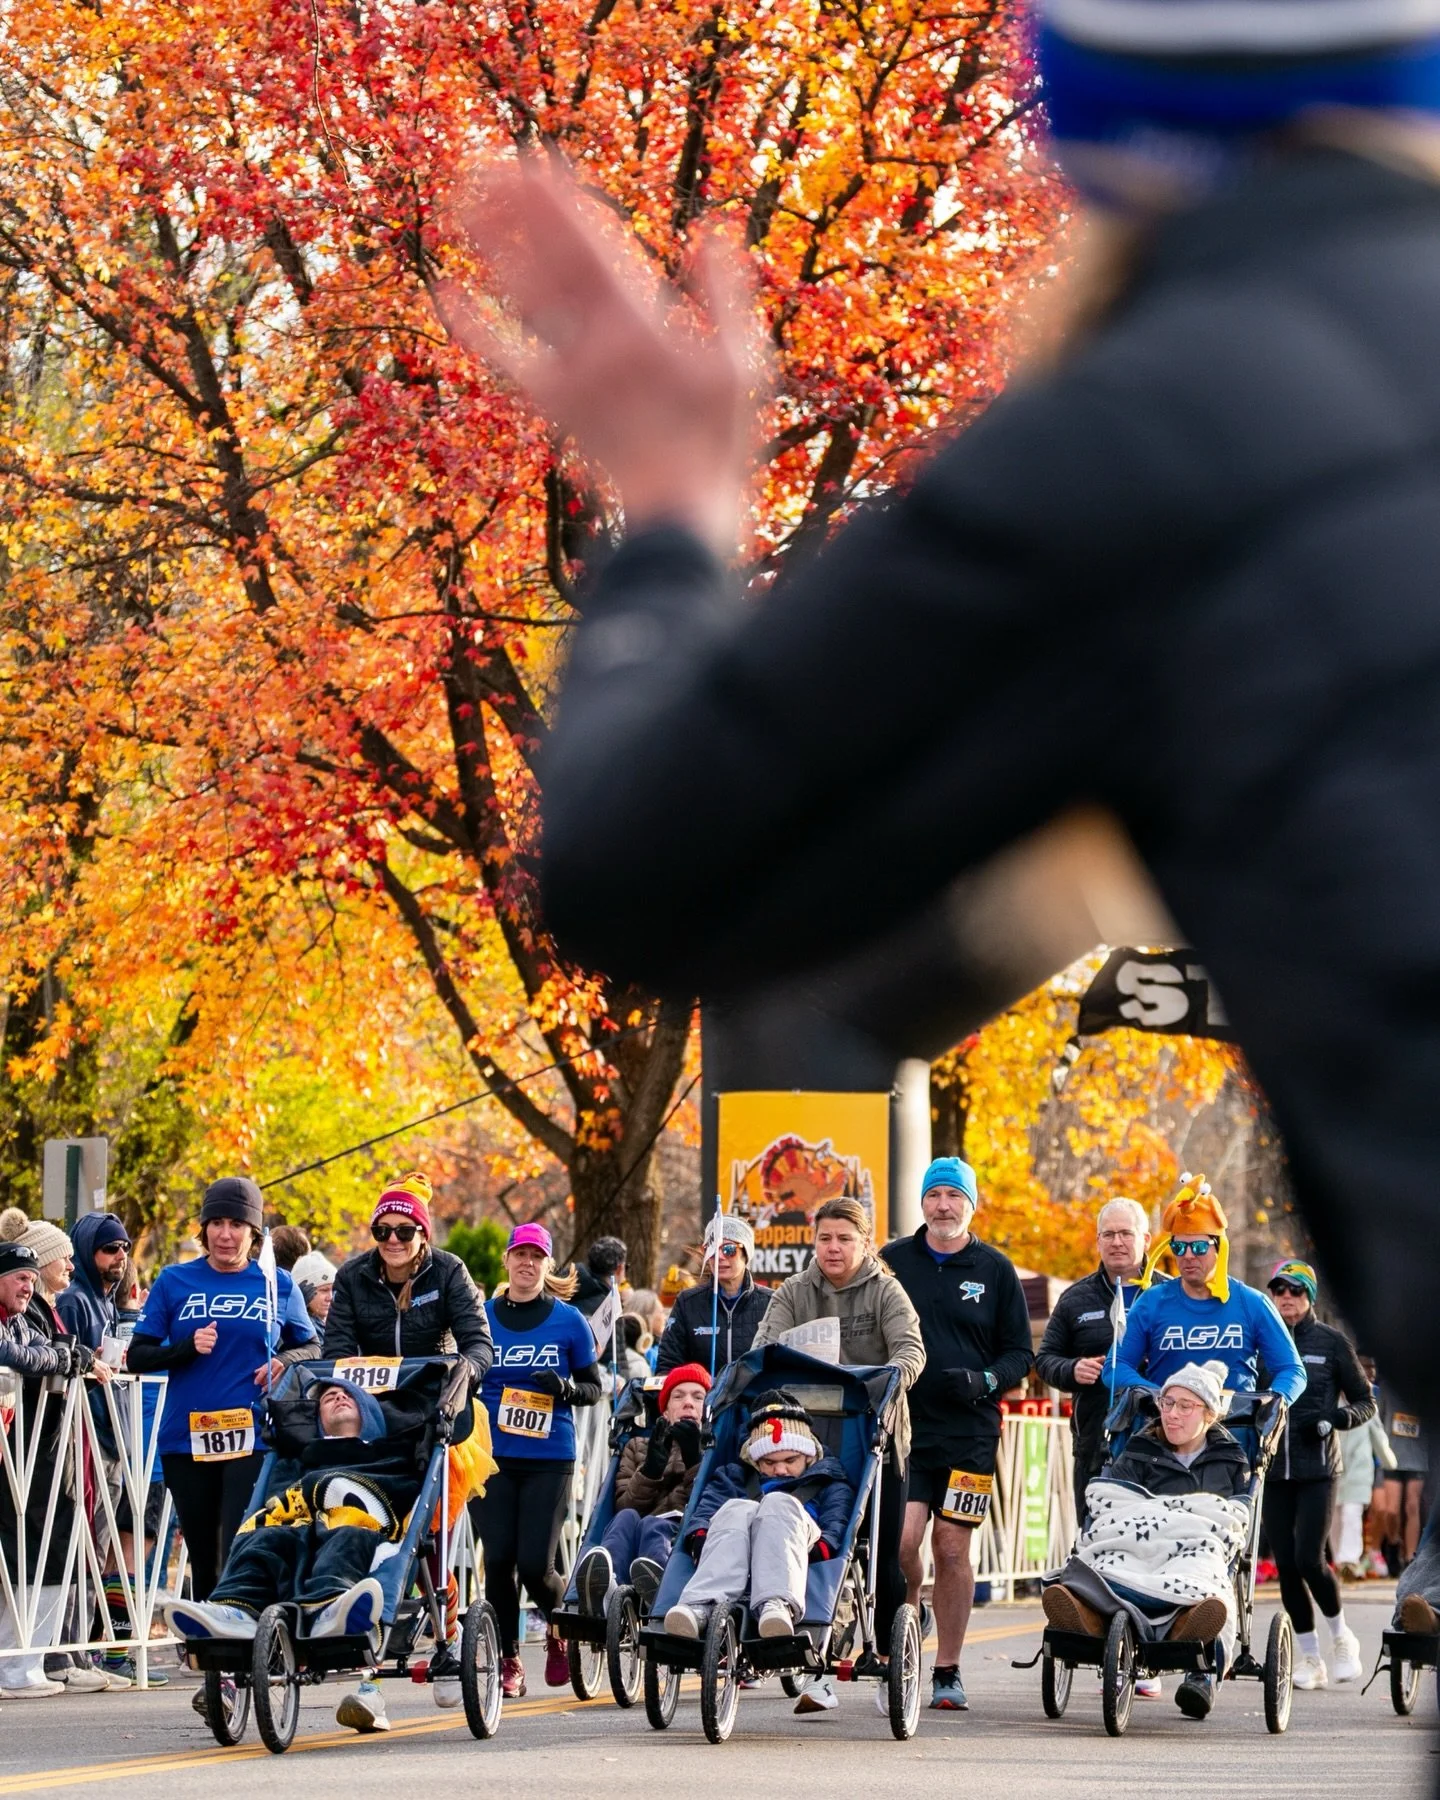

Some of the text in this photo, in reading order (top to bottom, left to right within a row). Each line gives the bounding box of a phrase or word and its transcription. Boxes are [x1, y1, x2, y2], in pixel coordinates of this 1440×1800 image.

[391, 1205, 413, 1215] TROT
[753, 1225, 815, 1245] eppar
[750, 1249, 806, 1273] RKEY
[178, 1293, 269, 1321] ASA
[1159, 1324, 1244, 1351] ASA
[341, 1367, 390, 1387] 1819
[505, 1407, 547, 1432] 1807
[200, 1429, 246, 1454] 1817
[953, 1491, 988, 1516] 1814
